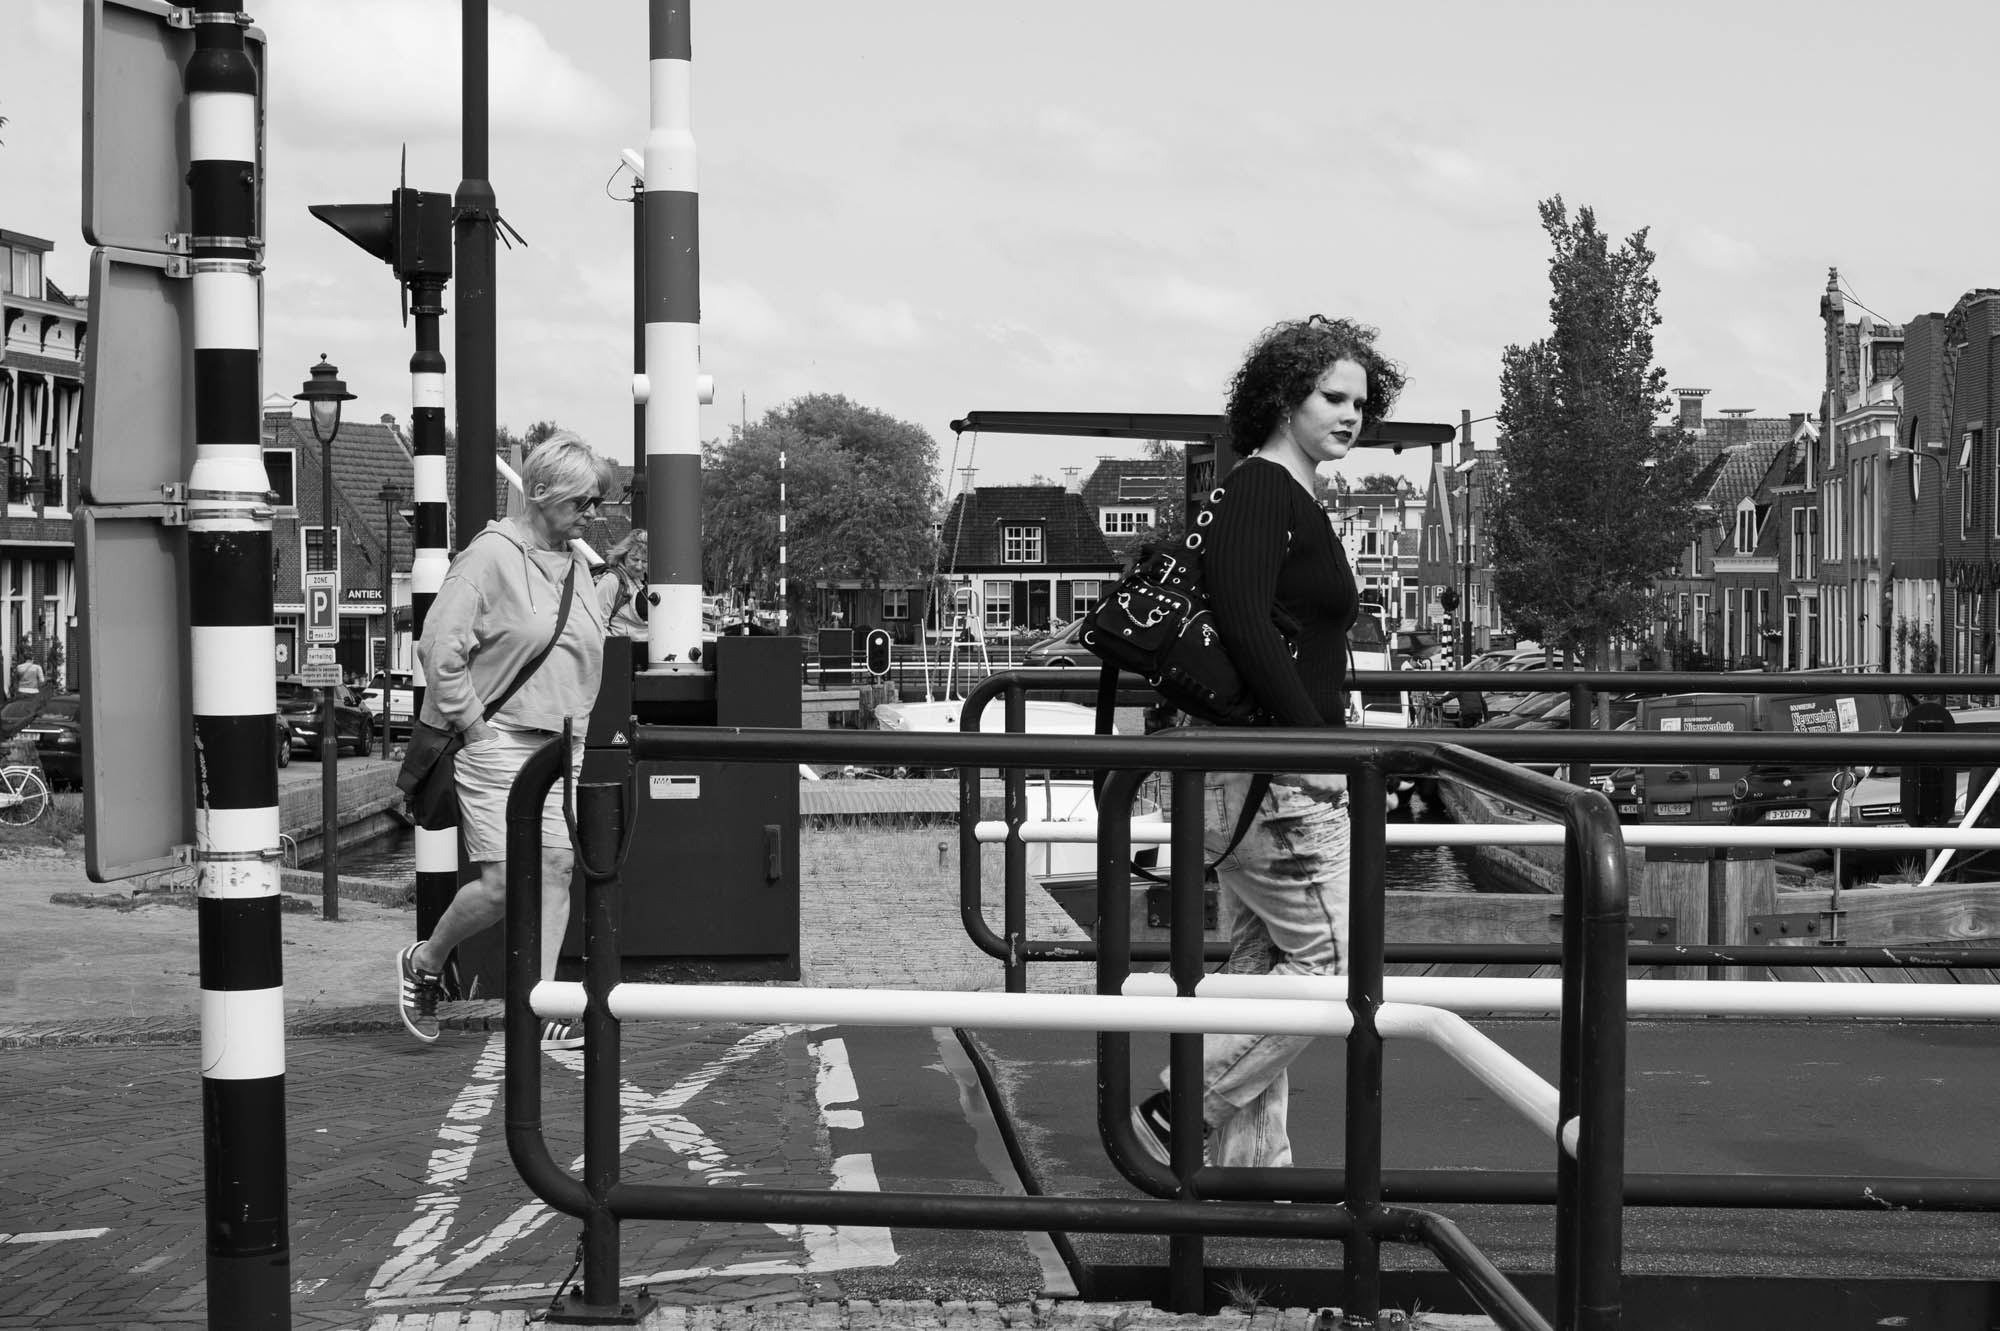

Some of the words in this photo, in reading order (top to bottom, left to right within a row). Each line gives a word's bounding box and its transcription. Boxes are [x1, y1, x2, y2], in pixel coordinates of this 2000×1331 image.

[313, 576, 328, 584] ZONE
[348, 590, 382, 599] ANTIEK
[1436, 587, 1444, 597] P
[314, 591, 328, 624] P
[1791, 708, 1837, 726] Nieuwenhuis
[1683, 721, 1735, 732] Nieuwenhuis
[1772, 809, 1808, 820] 3-XDT-79
